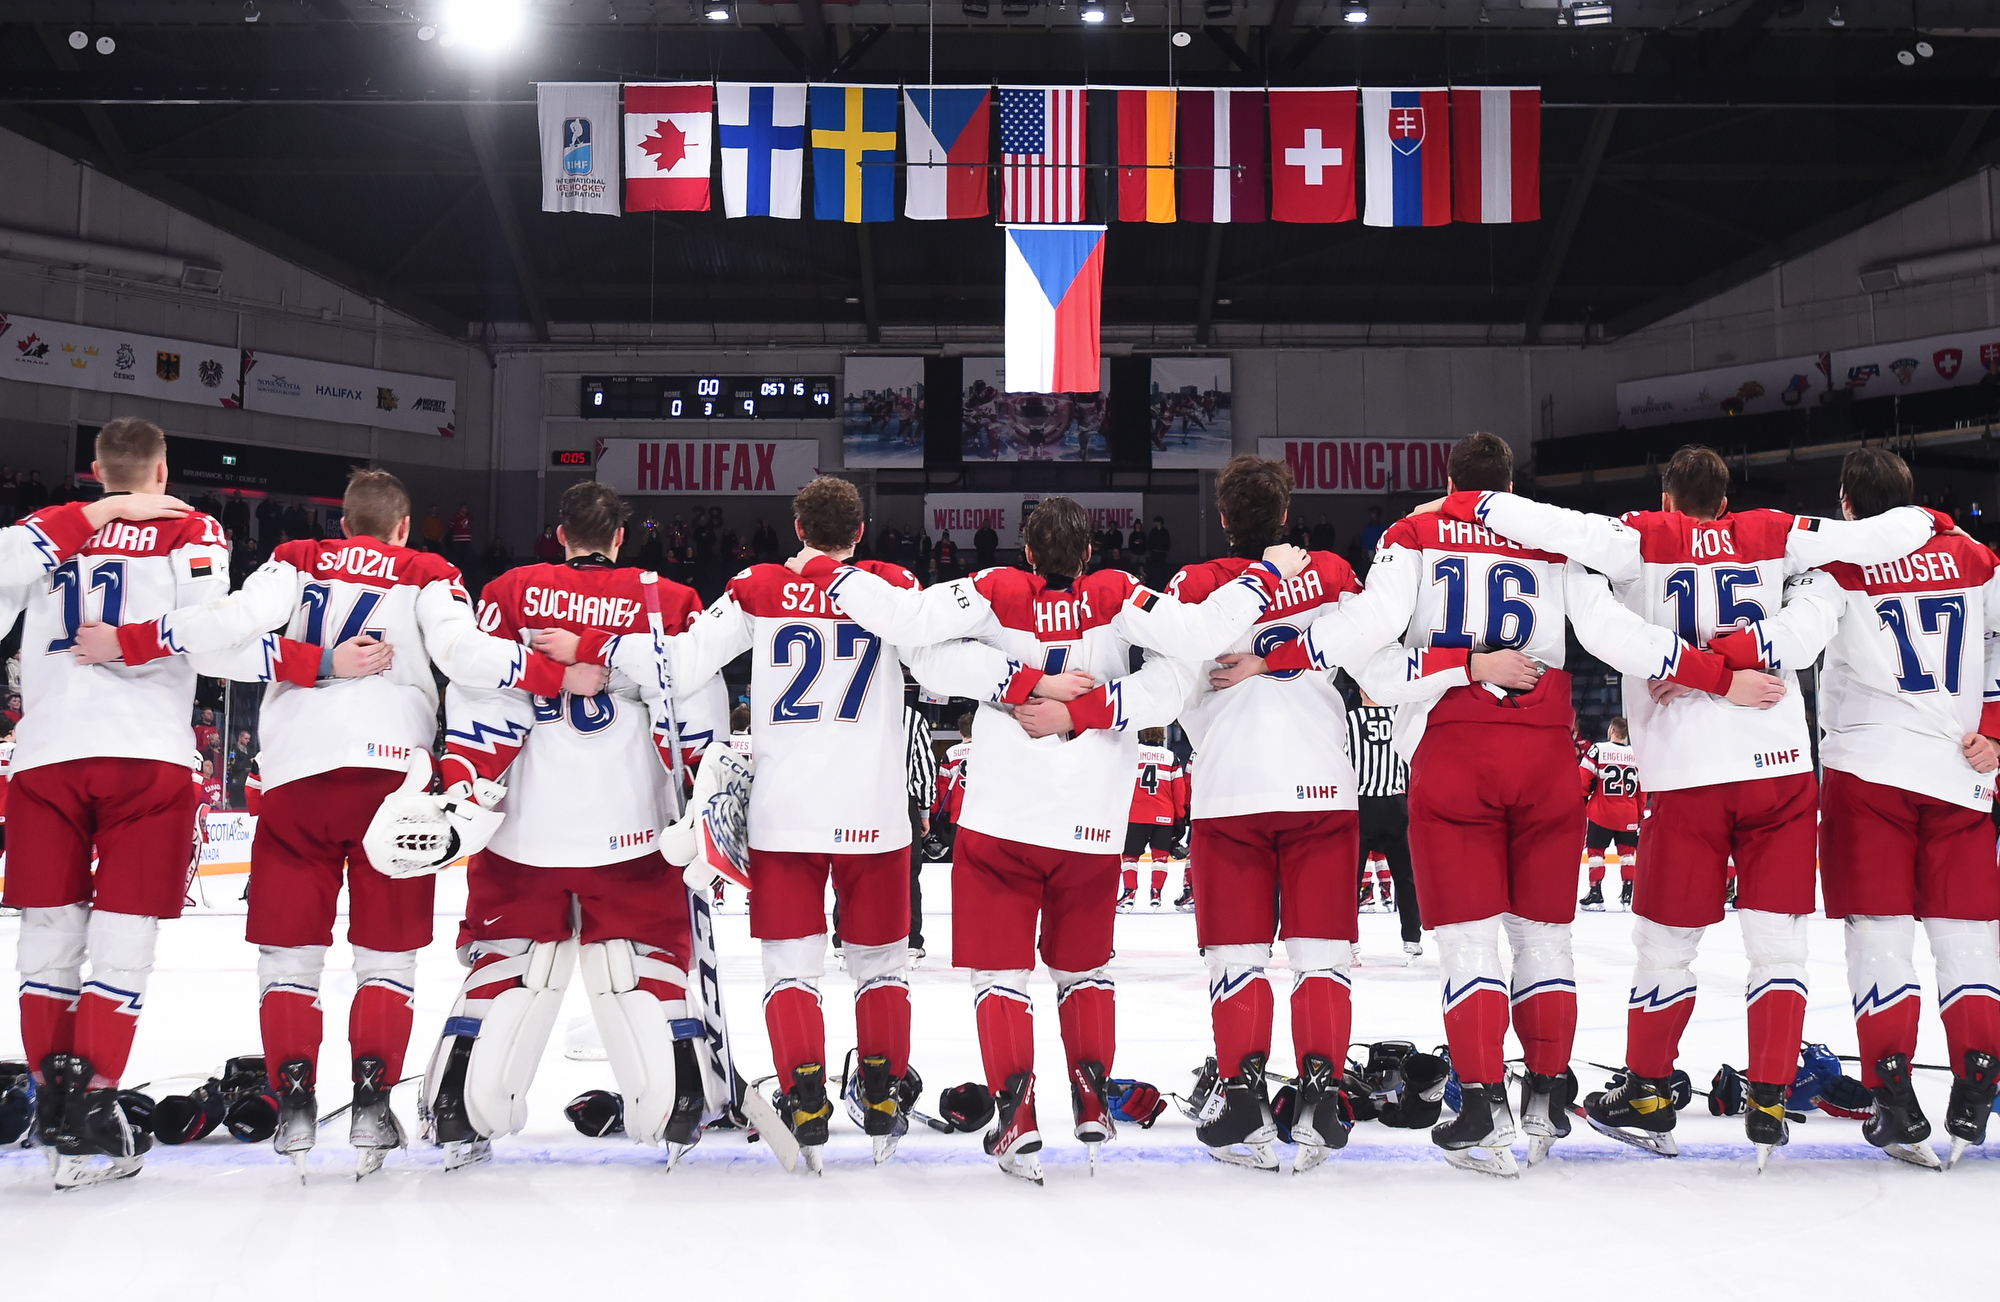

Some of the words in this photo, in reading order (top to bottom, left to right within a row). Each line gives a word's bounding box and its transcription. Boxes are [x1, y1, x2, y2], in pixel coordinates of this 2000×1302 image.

[567, 160, 588, 170] IIHF
[556, 184, 569, 192] ICE
[570, 183, 606, 192] HOCKEY
[15, 358, 49, 366] CANADA
[113, 370, 136, 381] ČESKO
[1848, 363, 1880, 380] USA
[257, 379, 276, 387] NOVA
[275, 380, 301, 391] SCOTIA
[315, 385, 362, 400] HALIFAX
[793, 383, 805, 396] 15
[422, 398, 447, 408] HOCKEY
[594, 392, 603, 406] 8
[671, 399, 682, 416] 0
[743, 399, 754, 415] 9
[814, 393, 829, 405] 47
[704, 402, 713, 416] 3
[560, 452, 585, 464] 10:05
[1285, 442, 1452, 490] MONCTON
[637, 443, 776, 491] HALIFAX
[183, 469, 223, 480] BRUNSWICK
[239, 475, 256, 483] DUKE
[933, 508, 1005, 530] WELCOME
[1437, 519, 1535, 550] MARC
[1692, 528, 1735, 558] KOS
[317, 547, 399, 581] SVOZIL
[1270, 569, 1324, 612] ARA
[45, 556, 128, 662] 11
[523, 586, 642, 628] SUCHANEK
[1428, 554, 1540, 652] 16
[1663, 565, 1768, 650] 15
[1873, 591, 1968, 697] 17
[768, 620, 882, 726] 27
[1366, 720, 1392, 742] 50
[1138, 751, 1165, 762] INDNER
[1764, 749, 1800, 766] IIHF
[1140, 763, 1160, 795] 4
[1603, 764, 1638, 798] 26
[1306, 785, 1338, 799] IIHF
[620, 829, 655, 848] IIHF
[845, 829, 880, 843] IIHF
[1085, 826, 1112, 843] IIHF
[692, 893, 727, 1083] CCM
[1075, 1069, 1090, 1093] CCM
